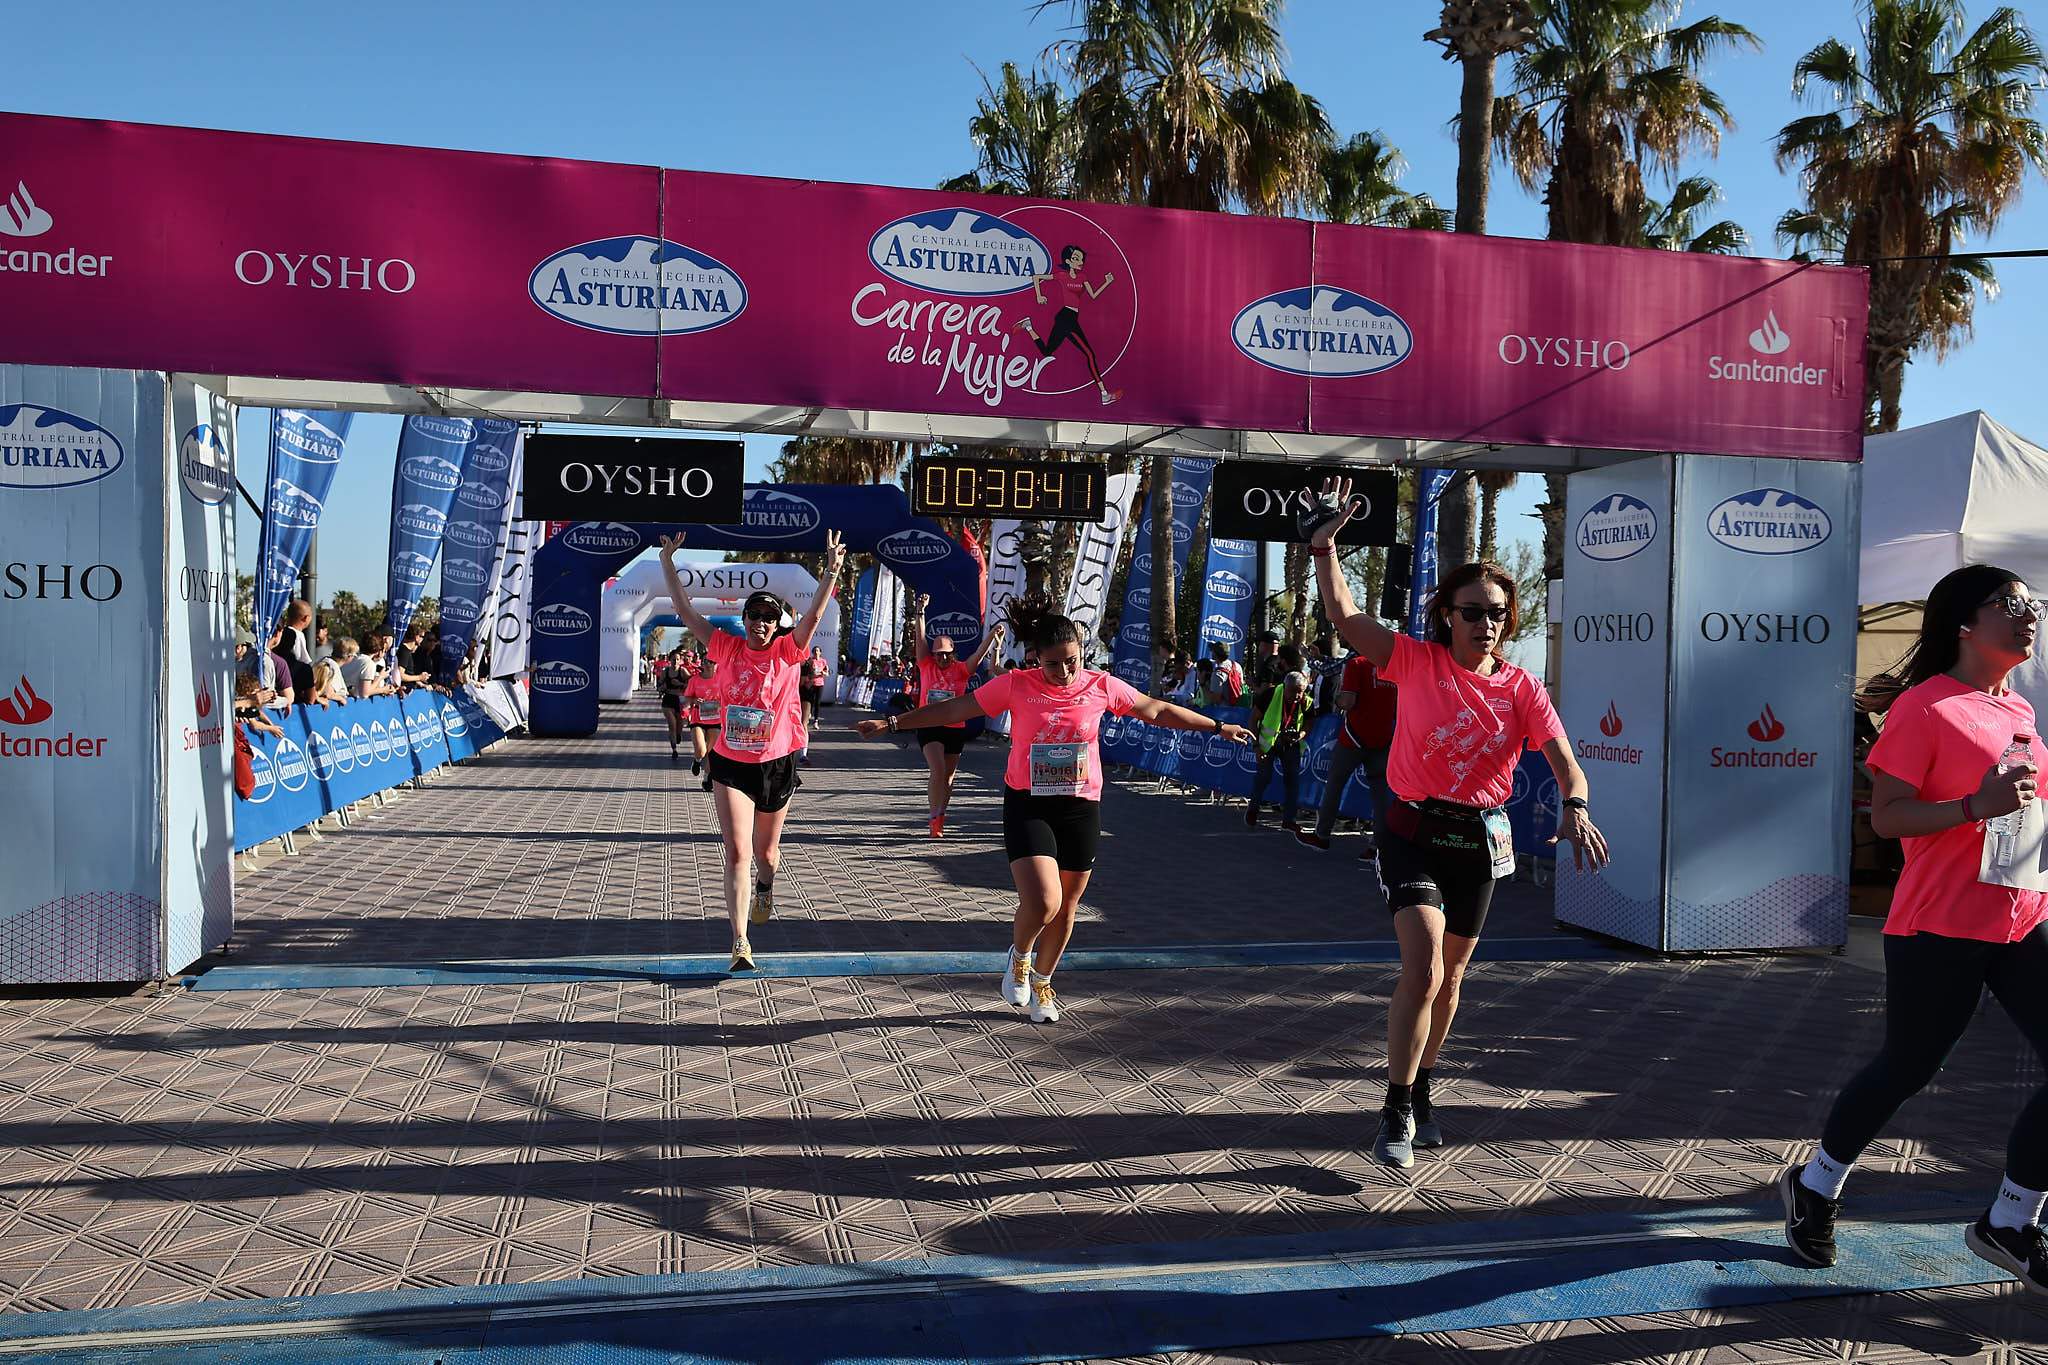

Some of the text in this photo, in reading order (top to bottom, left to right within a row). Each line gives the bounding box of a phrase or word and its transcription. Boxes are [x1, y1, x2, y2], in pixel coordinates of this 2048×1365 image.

[882, 235, 1036, 277] ASTURIANA
[912, 235, 1032, 252] CENTRAL LECHERA
[234, 250, 416, 294] OYSHO
[581, 267, 724, 284] CENTRAL LECHERA
[546, 267, 731, 313] ASTURIANA
[851, 283, 1002, 337] Carrera
[1275, 315, 1393, 330] CENTRAL LECHERA
[1245, 315, 1399, 357] ASTURIANA
[1499, 334, 1631, 371] OYSHO
[888, 333, 1056, 407] de la Mujer
[1708, 354, 1827, 387] Santander
[0, 432, 103, 445] TRAL LECHERA
[0, 445, 109, 470] URIANA
[560, 462, 714, 498] OYSHO
[926, 467, 1092, 510] 00:38:41
[1243, 487, 1372, 521] OYSO
[1735, 510, 1818, 520] CENTRAL LECHERA
[1580, 522, 1651, 547] ASTURIANA
[1716, 511, 1822, 540] ASTURIANA
[567, 532, 634, 547] ASTURIANA
[883, 543, 947, 555] ASTURIANA
[0, 563, 123, 602] SHO
[180, 566, 230, 605] OYSHO
[615, 588, 645, 596] OYSHO
[676, 568, 769, 590] OYSHO
[535, 615, 588, 629] ASTURIANA
[1574, 612, 1654, 643] OYSHO
[1701, 612, 1830, 644] OYSHO
[534, 672, 586, 686] ASTURIANA
[0, 731, 108, 758] tander
[183, 725, 225, 752] Santander
[1577, 739, 1643, 765] Santander
[1710, 747, 1818, 769] Santander
[1817, 1156, 1833, 1173] UP
[2003, 1188, 2021, 1202] UP
